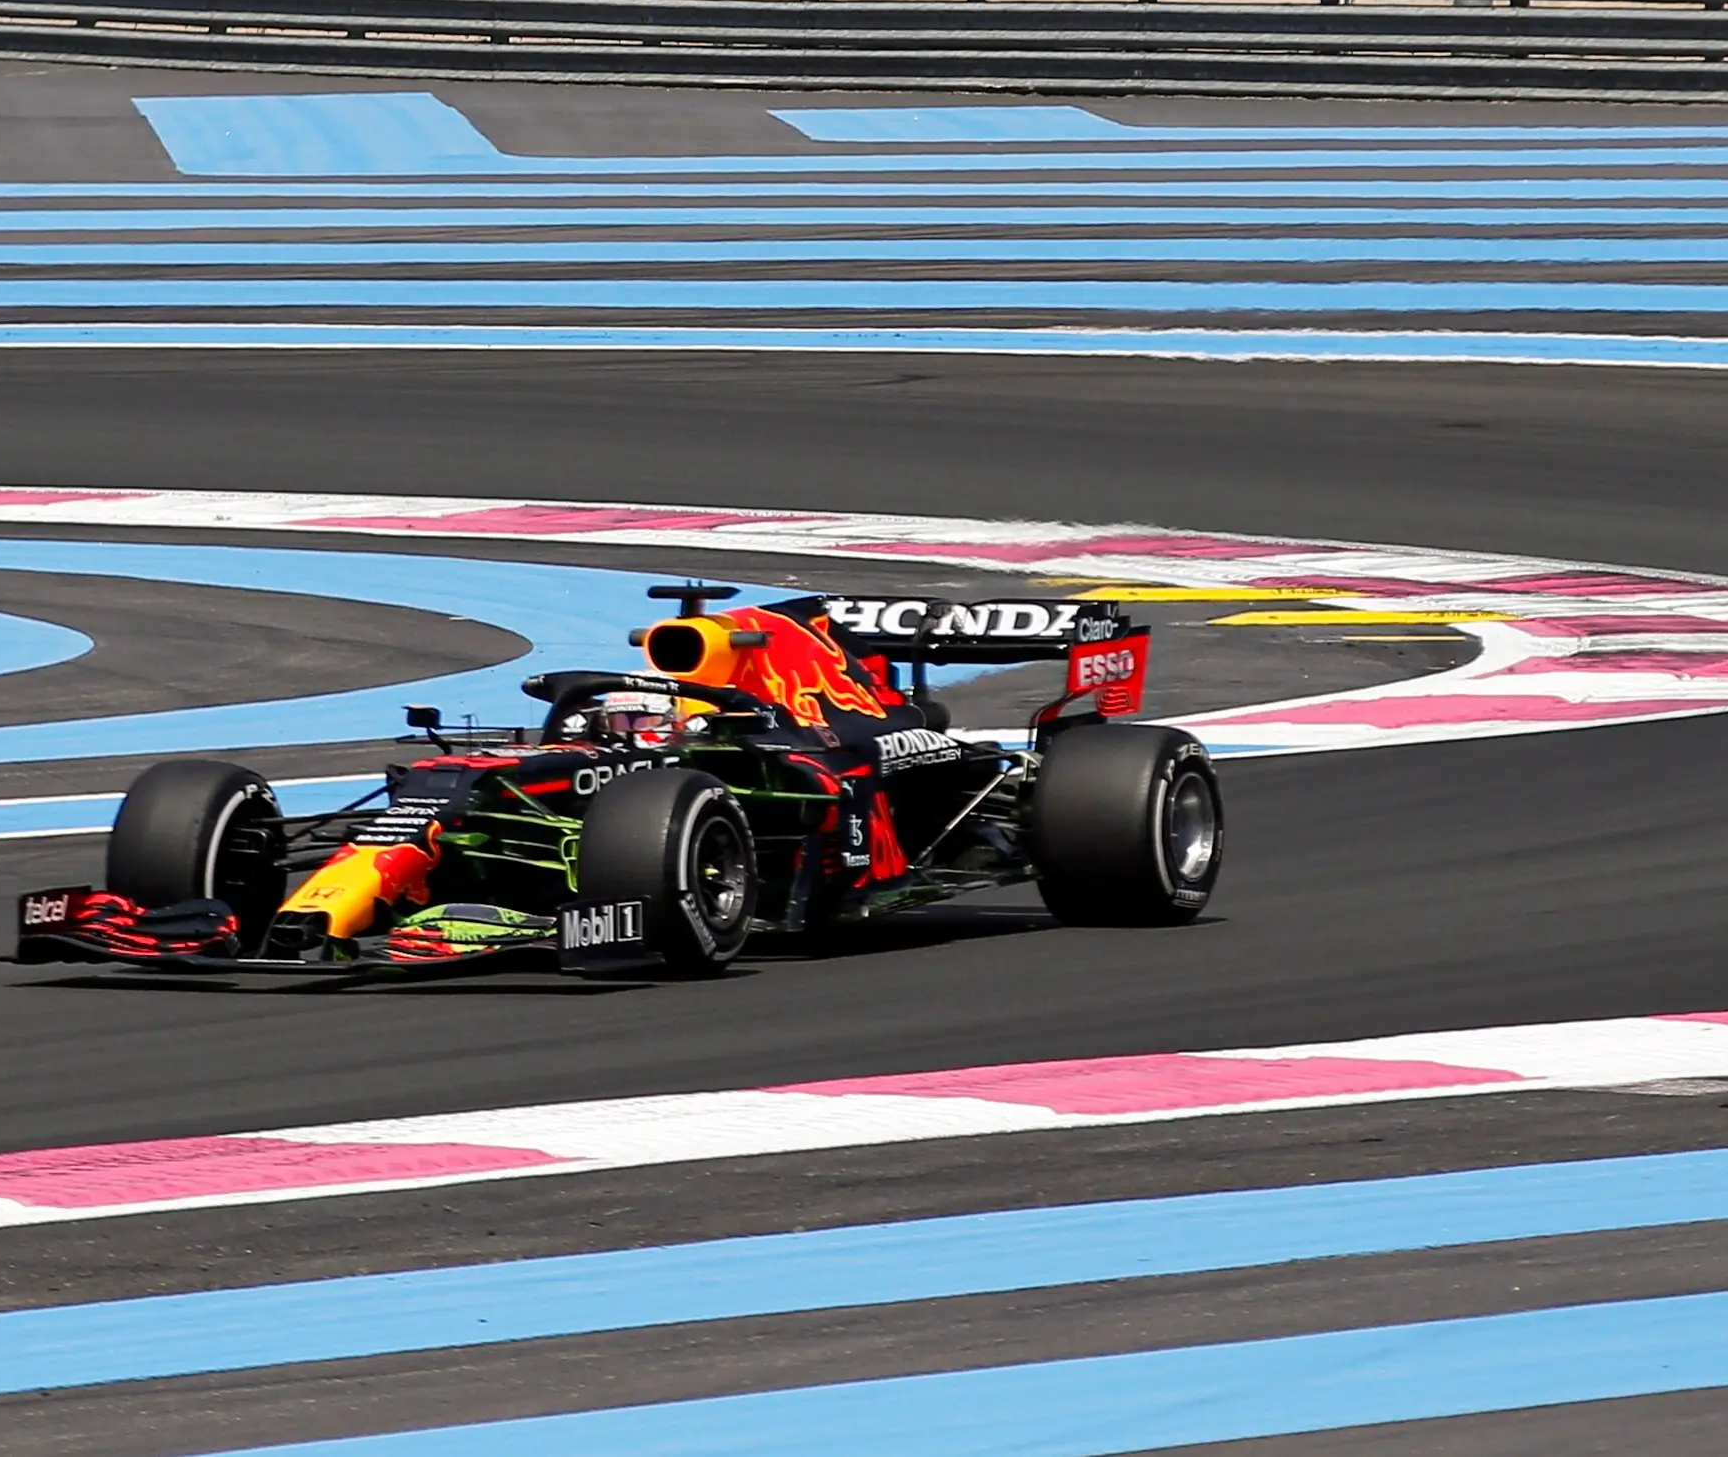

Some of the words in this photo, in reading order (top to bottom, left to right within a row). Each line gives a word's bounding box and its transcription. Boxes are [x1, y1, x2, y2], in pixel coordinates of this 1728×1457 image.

[824, 600, 1081, 636] HONDA
[1079, 649, 1135, 687] ESSO
[873, 727, 958, 760] HONDA
[24, 893, 70, 925] telcel
[564, 904, 615, 949] Mobil
[622, 905, 634, 938] 1
